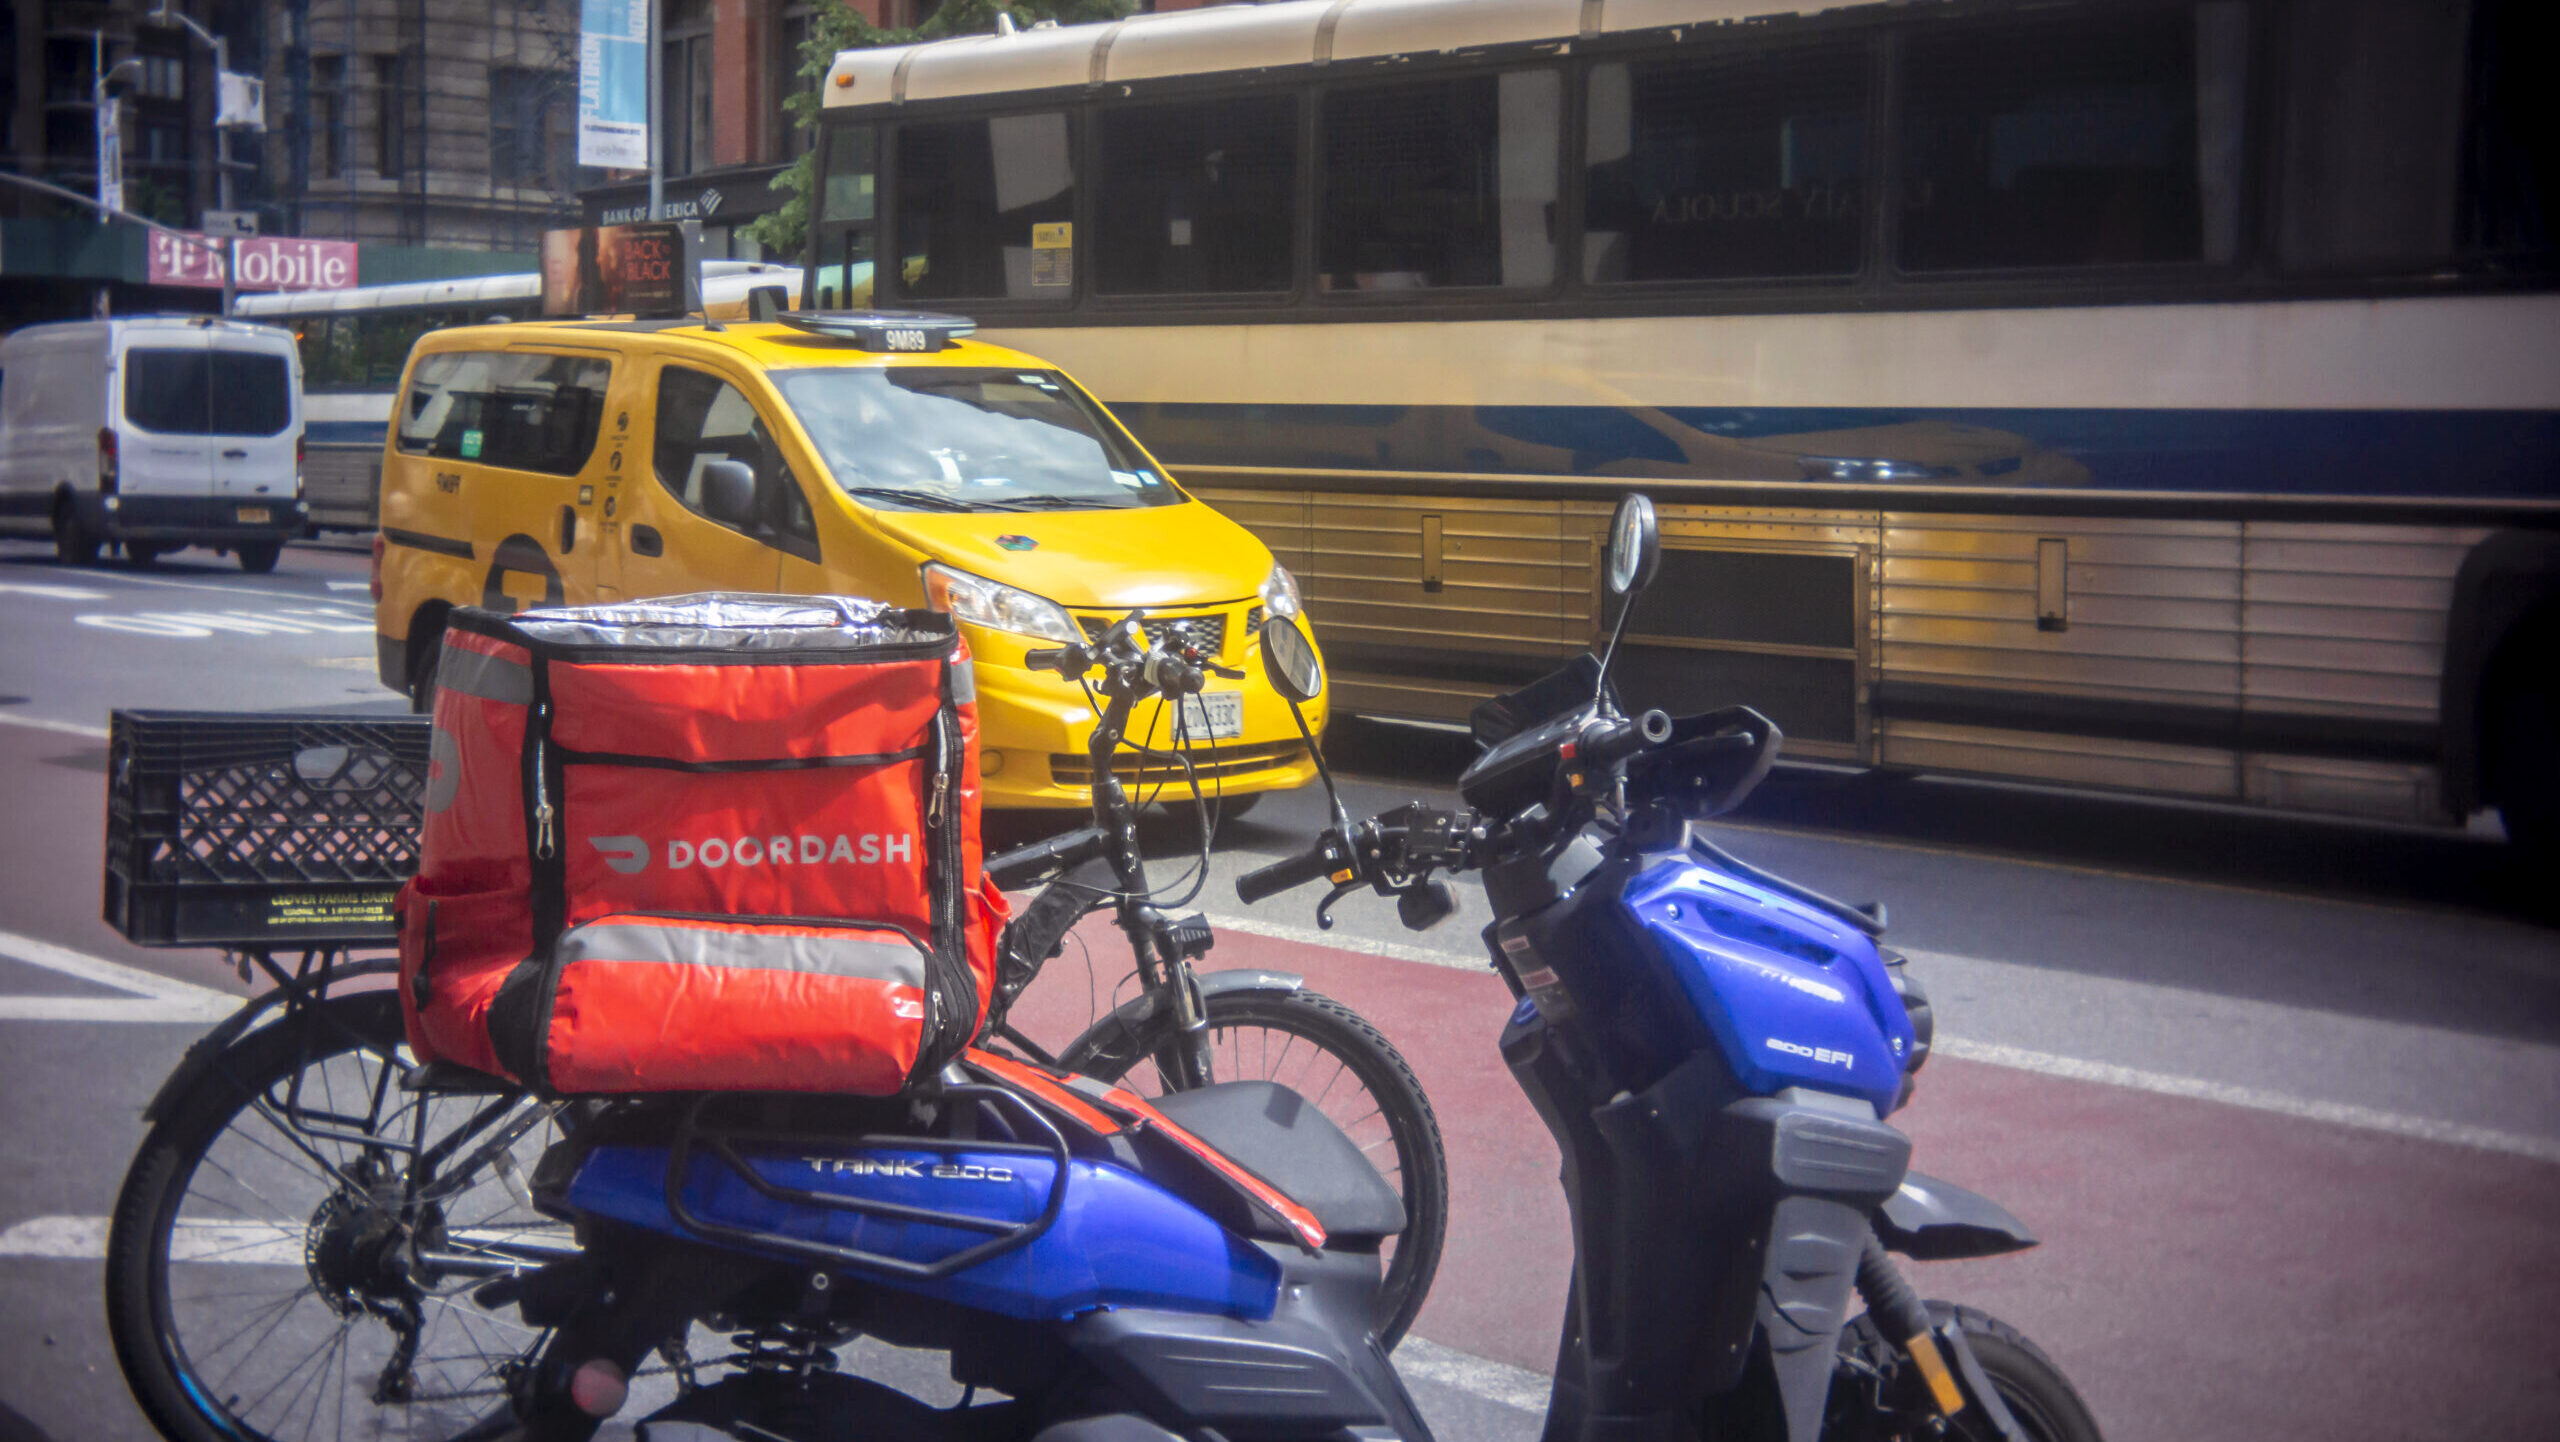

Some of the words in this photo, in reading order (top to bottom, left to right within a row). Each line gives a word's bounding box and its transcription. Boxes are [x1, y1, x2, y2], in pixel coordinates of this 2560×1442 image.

[602, 209, 632, 225] BANK
[633, 207, 646, 221] OF
[653, 201, 698, 219] ERICA
[624, 239, 662, 260] BACK
[626, 261, 671, 281] BLACK
[886, 330, 926, 351] 9M89
[668, 833, 911, 869] DOORDASH
[271, 894, 316, 905] CLOVER
[319, 893, 359, 904] FARMS
[801, 1156, 924, 1178] TANK
[932, 1163, 1013, 1182] 200
